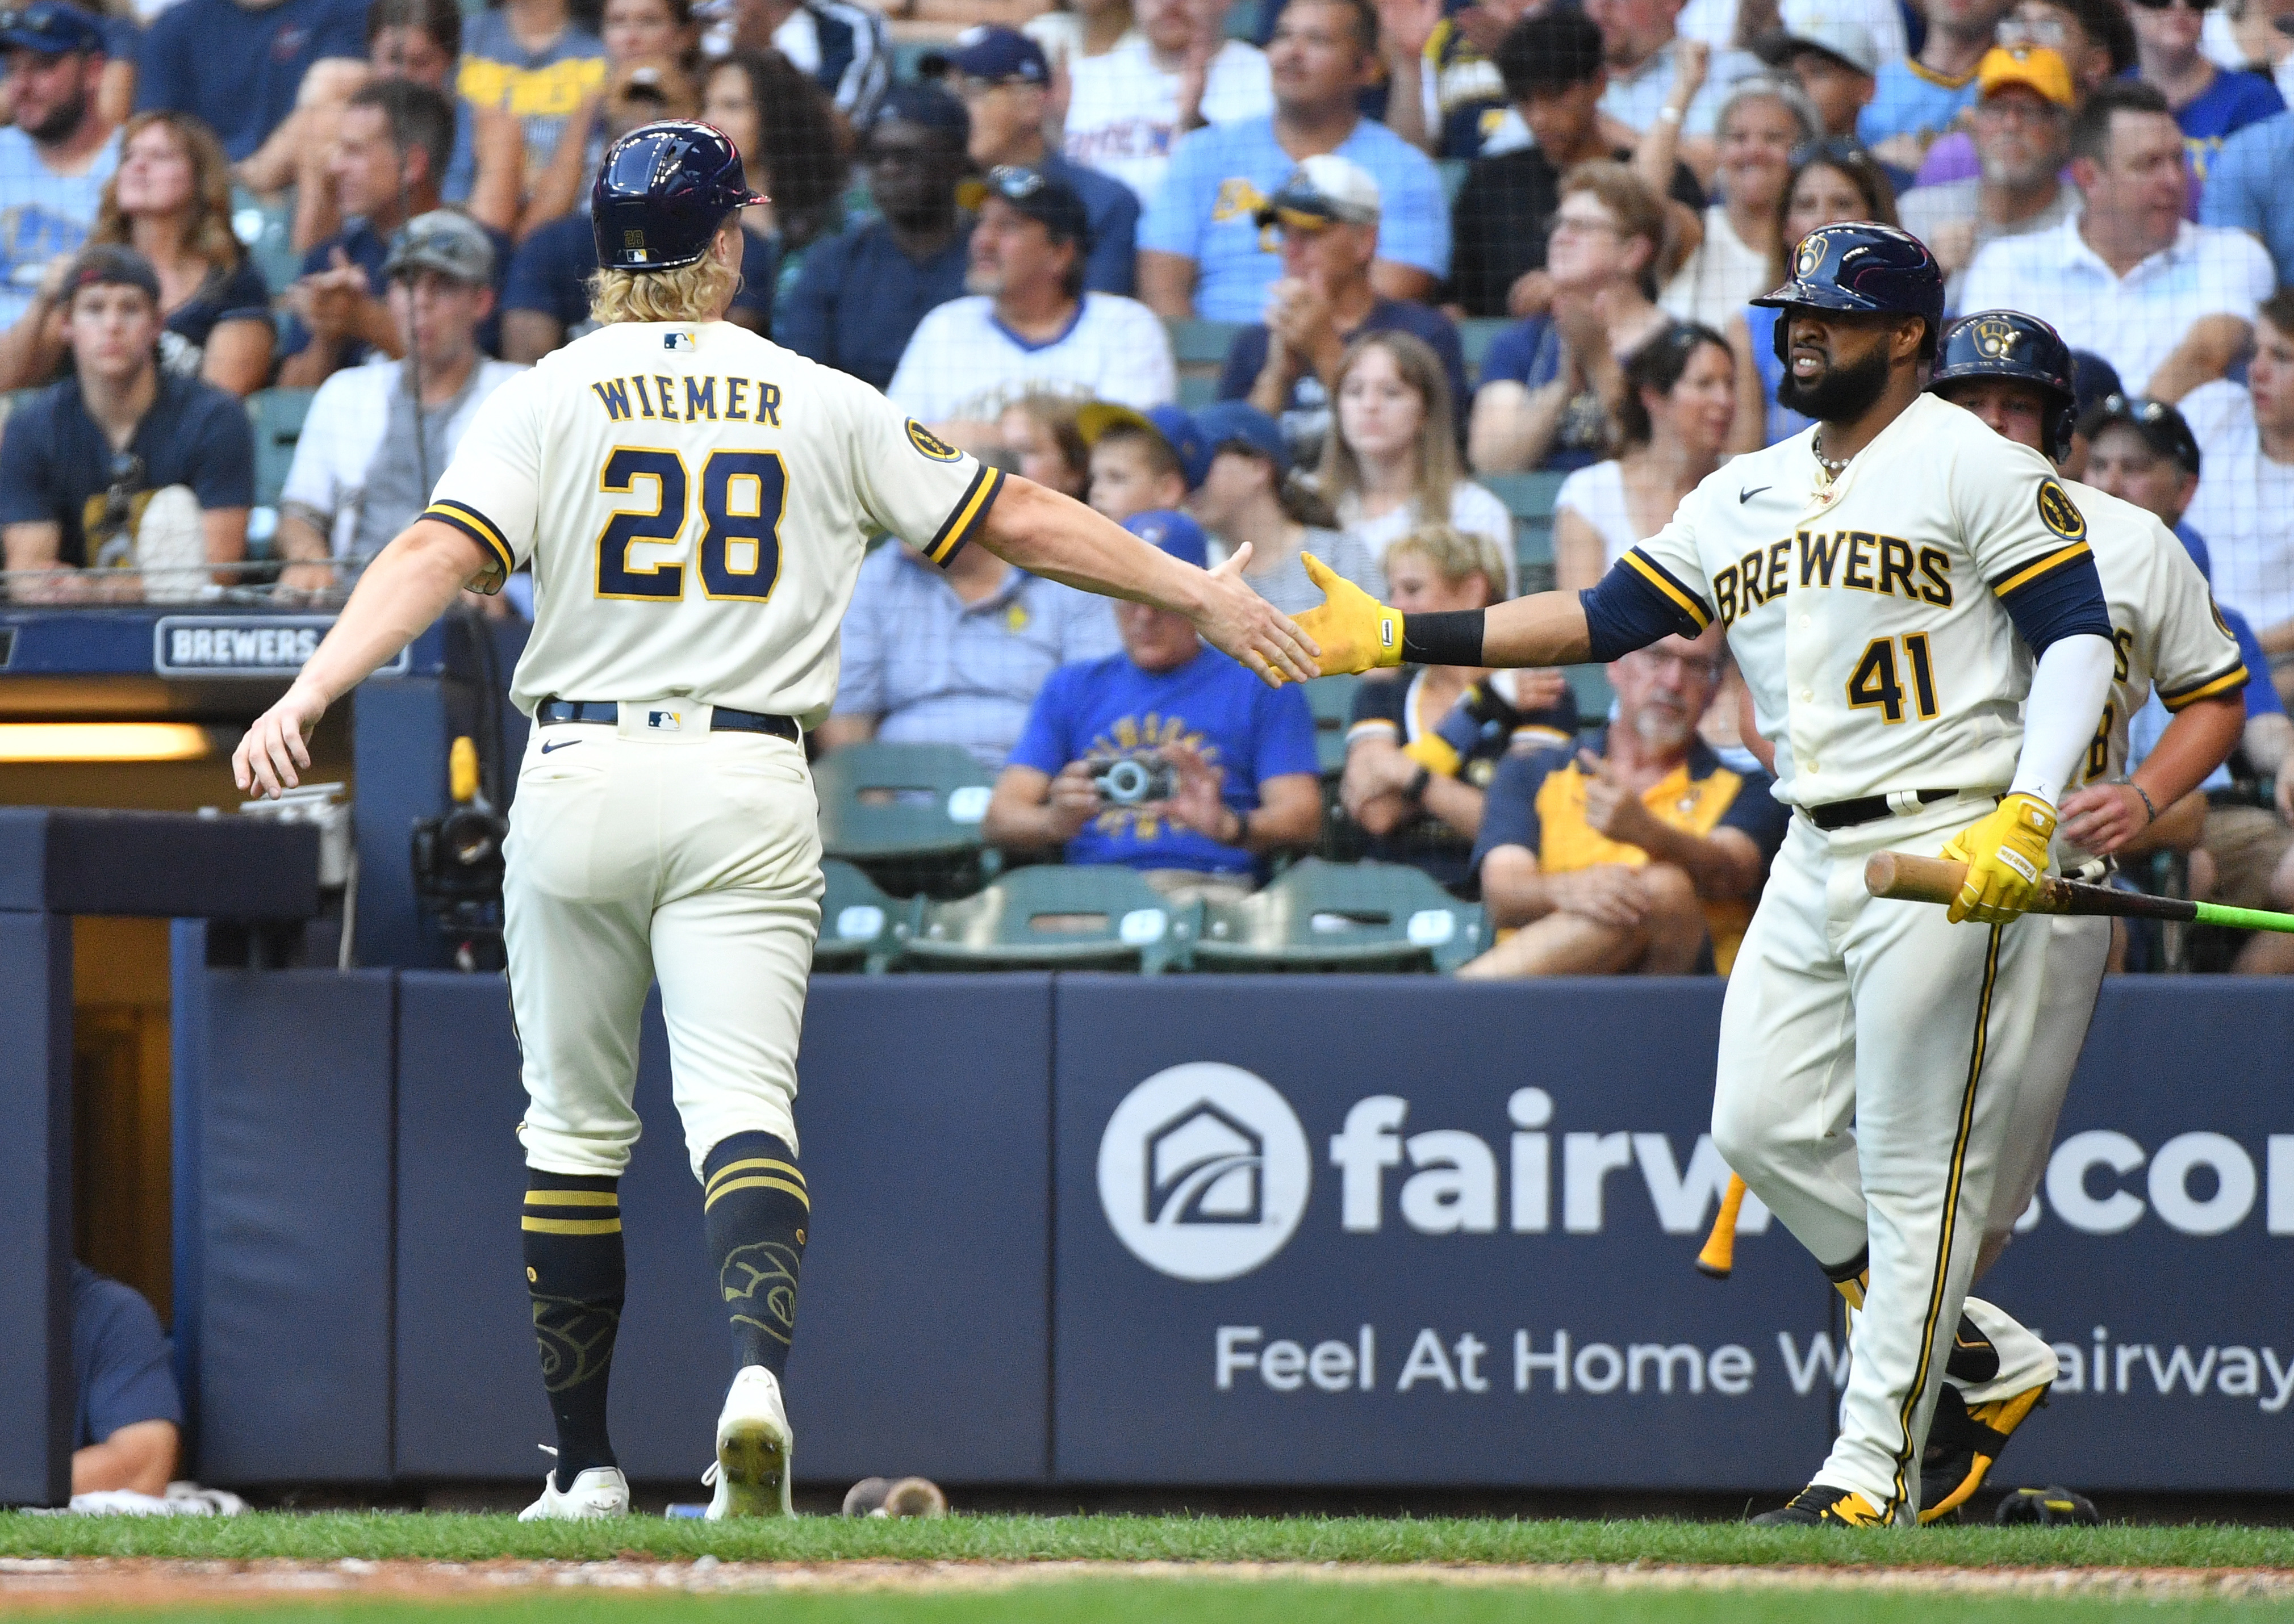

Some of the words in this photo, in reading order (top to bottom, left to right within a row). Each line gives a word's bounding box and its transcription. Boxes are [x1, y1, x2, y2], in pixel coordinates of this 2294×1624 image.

[624, 230, 644, 248] 28
[590, 372, 783, 430] WIEMER
[594, 445, 790, 603] 28
[1712, 529, 1955, 634] BREWERS
[172, 629, 319, 664] BREWERS
[1845, 631, 1941, 725] 41
[1215, 1324, 1375, 1391] Feel
[1396, 1327, 1489, 1391] At
[1514, 1328, 1756, 1394] Home
[2029, 1325, 2294, 1413] airway
